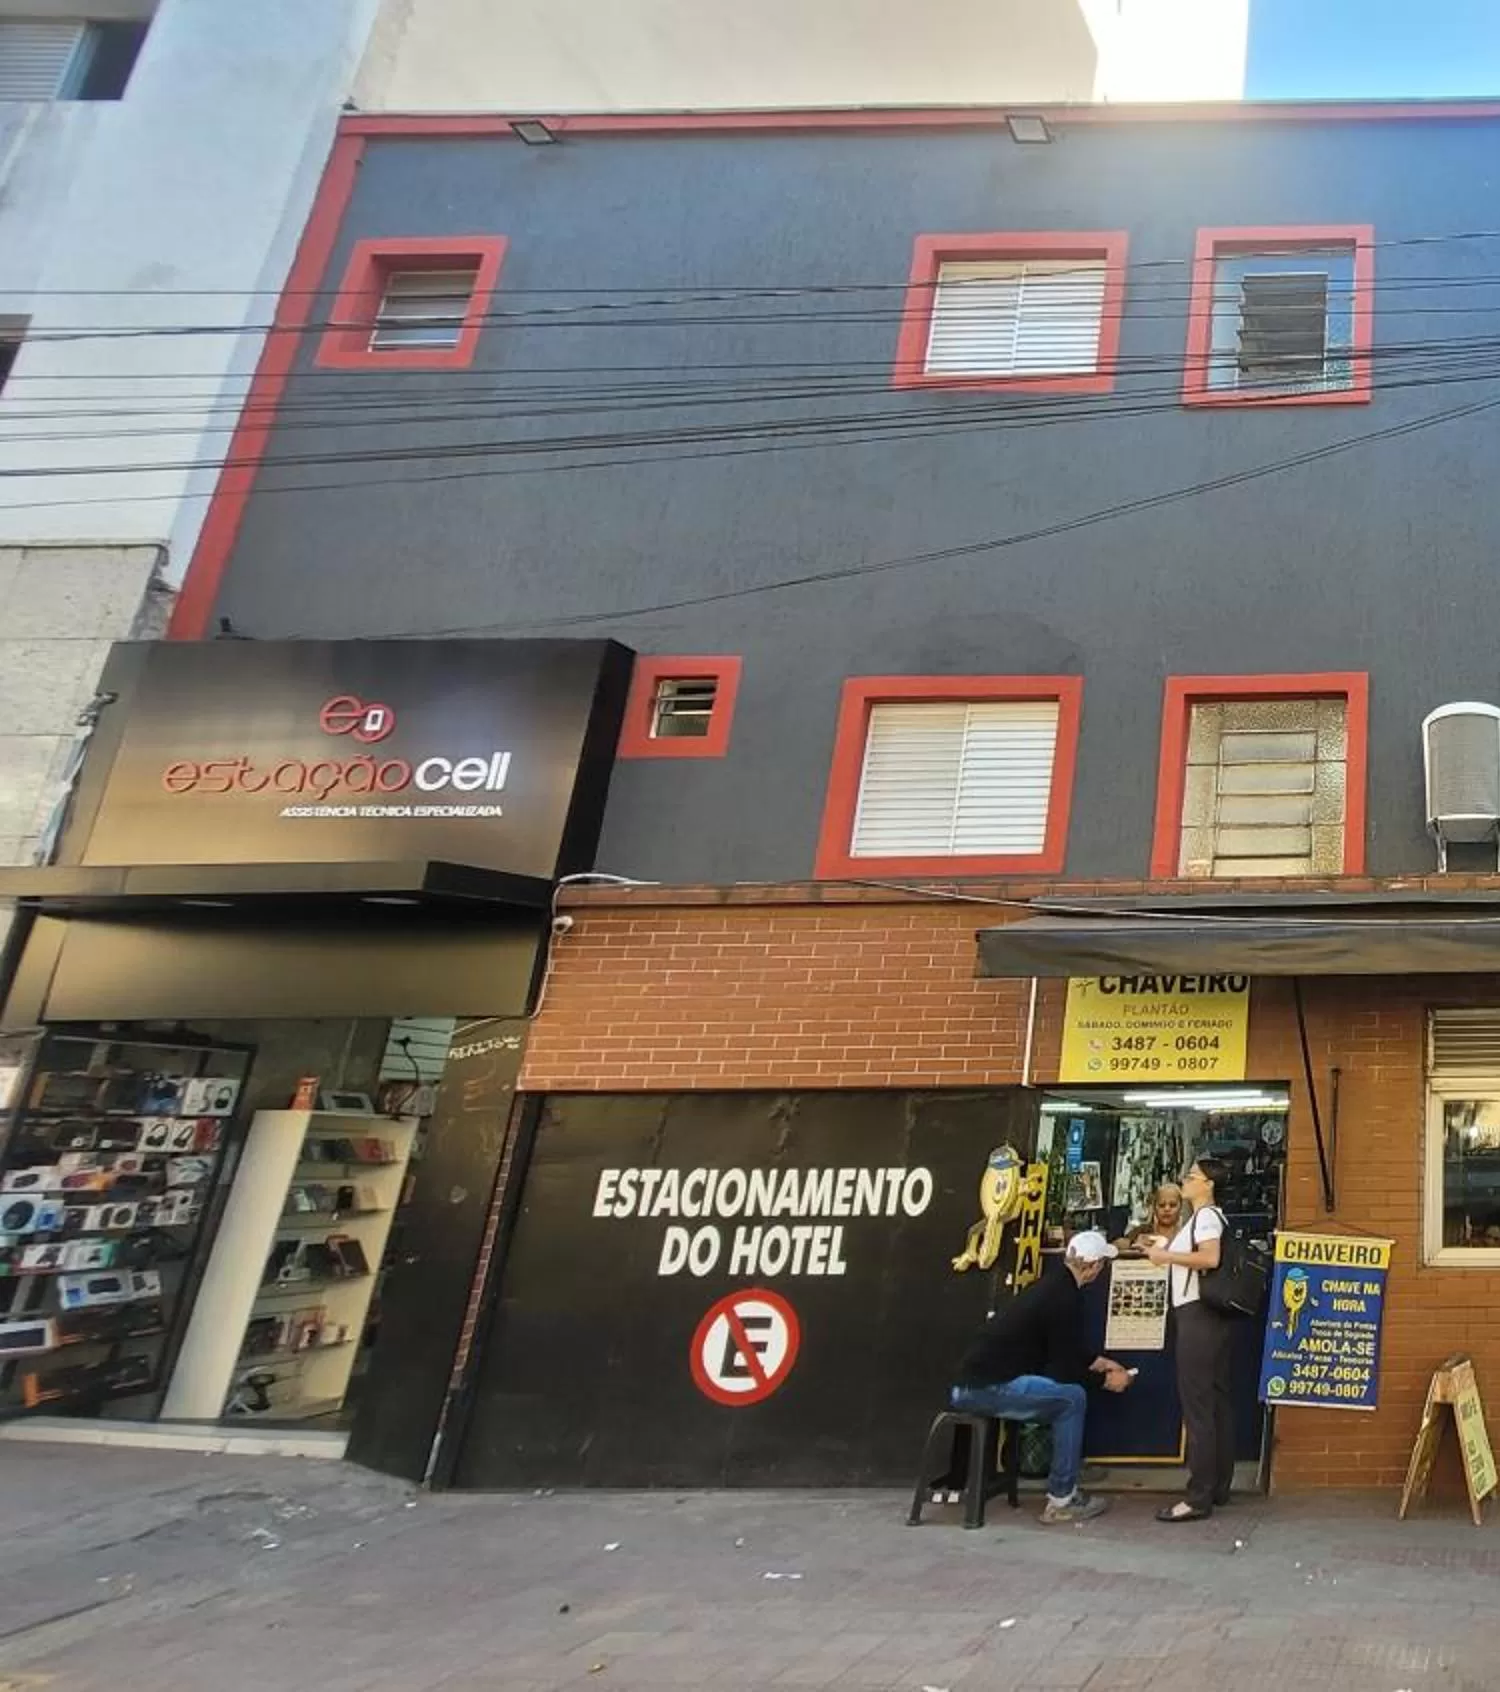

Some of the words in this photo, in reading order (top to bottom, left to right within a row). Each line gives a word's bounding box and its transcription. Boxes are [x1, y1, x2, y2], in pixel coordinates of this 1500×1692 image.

[413, 805, 503, 817] ESPECIALIZADA
[1099, 975, 1248, 994] CHAVEIRO
[1126, 1020, 1175, 1029] DOMINGO
[1187, 1020, 1233, 1028] FERIADO
[1112, 1036, 1156, 1050] 3487
[1175, 1036, 1220, 1050] 0604
[1110, 1057, 1160, 1070] 99749
[1178, 1057, 1219, 1070] 0807
[592, 1167, 933, 1218] ESTACIONAMENTO
[657, 1226, 721, 1277] DO
[728, 1226, 847, 1277] HOTEL
[1284, 1241, 1381, 1264] CHAVEIRO
[1321, 1280, 1361, 1295] CHAVE
[1363, 1281, 1381, 1296] NA
[1333, 1298, 1366, 1312] HORA
[1298, 1337, 1376, 1357] AMOLA-SE
[1292, 1363, 1370, 1381] 3487-0604
[1289, 1380, 1368, 1399] 99749-0807
